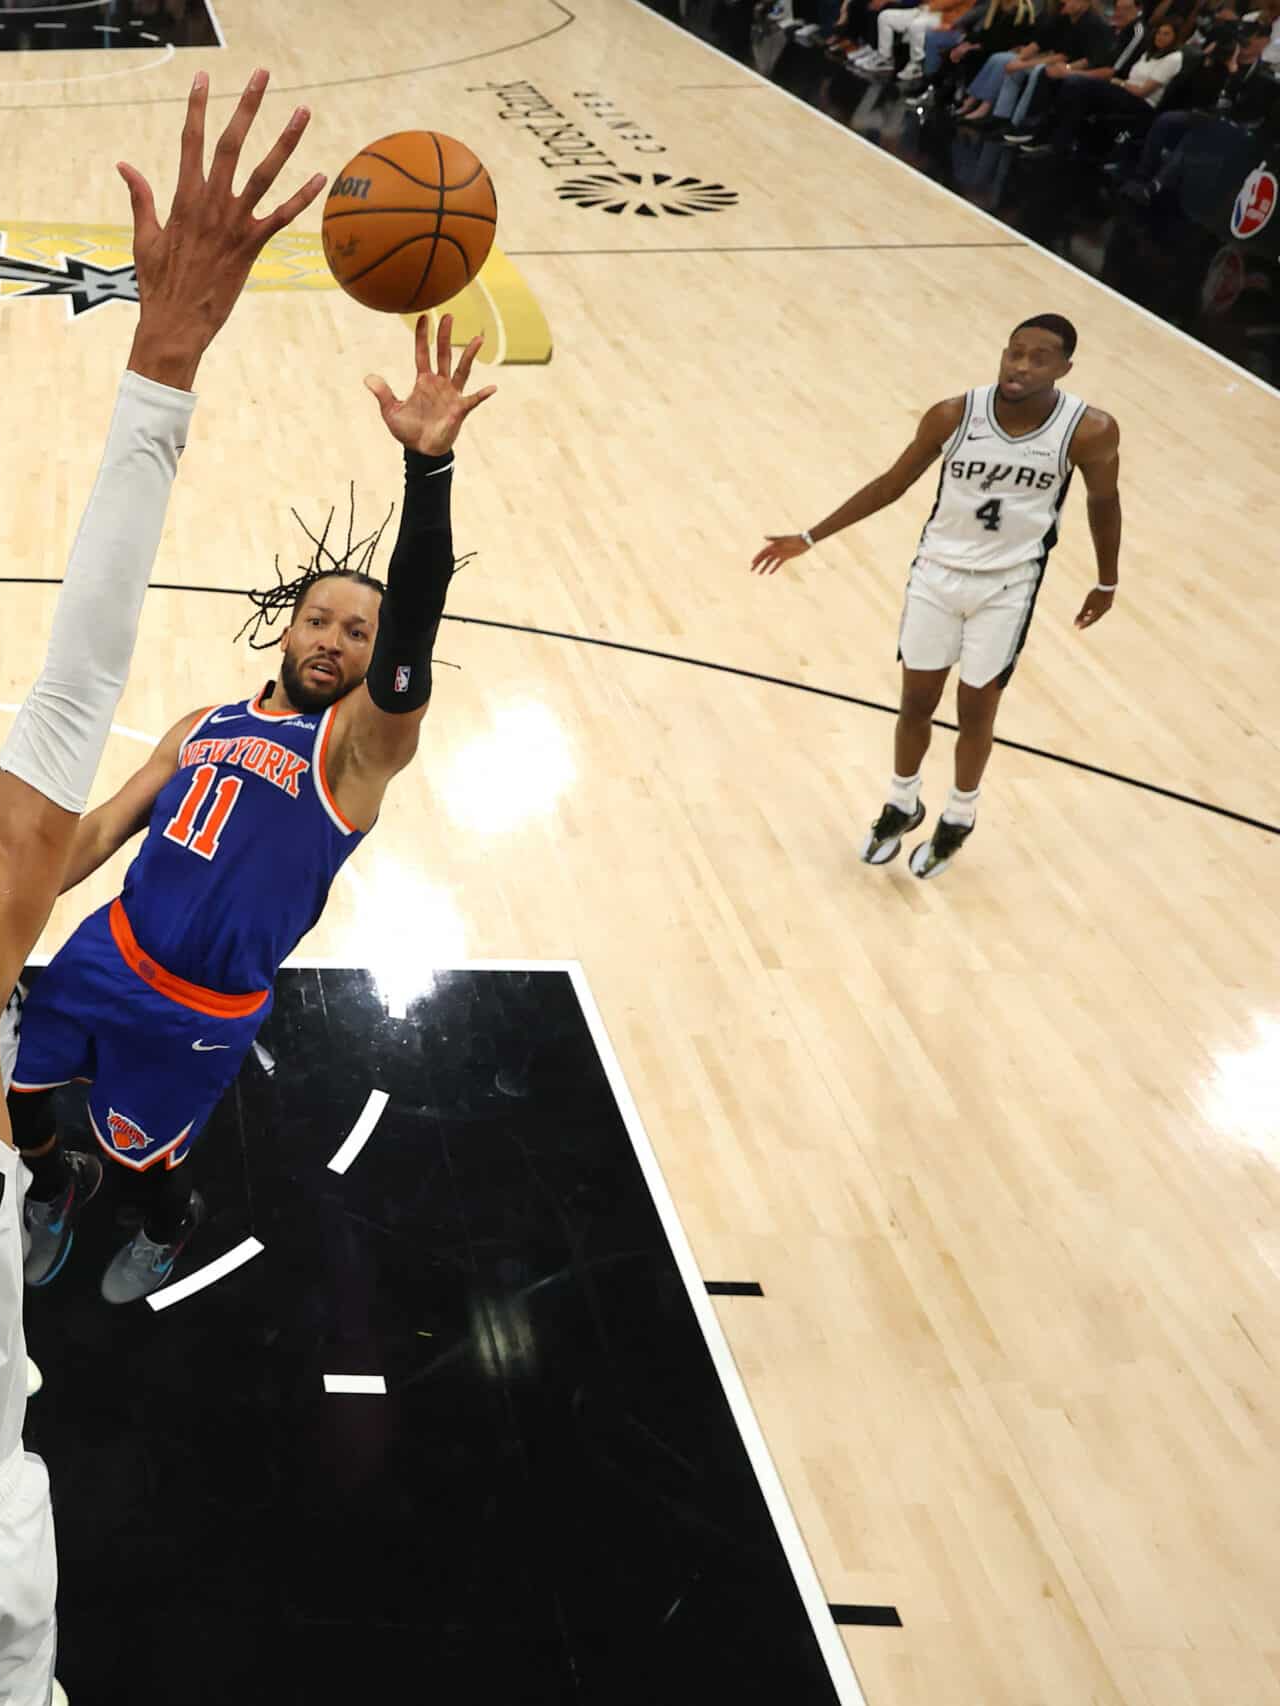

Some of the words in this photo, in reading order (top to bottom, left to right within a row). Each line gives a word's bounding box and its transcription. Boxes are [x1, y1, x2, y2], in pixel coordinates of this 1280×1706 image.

[951, 461, 1055, 491] SPURS
[976, 498, 1002, 531] 4
[226, 736, 311, 799] YORK
[162, 763, 243, 861] 11
